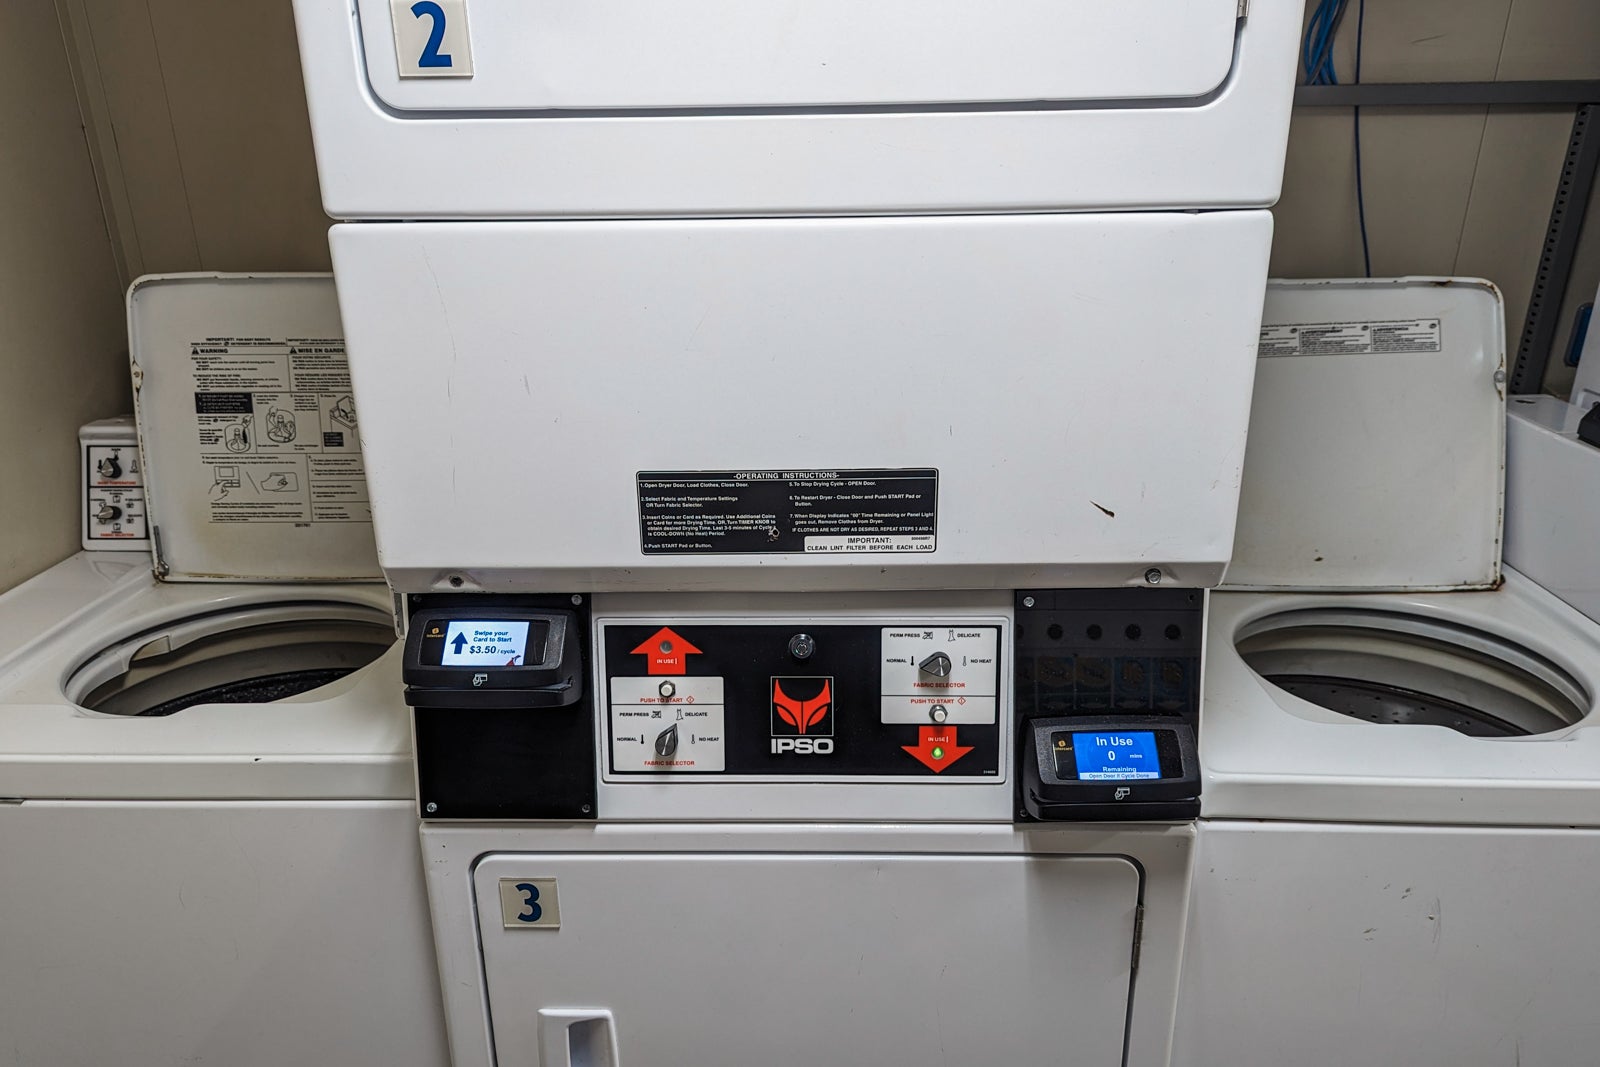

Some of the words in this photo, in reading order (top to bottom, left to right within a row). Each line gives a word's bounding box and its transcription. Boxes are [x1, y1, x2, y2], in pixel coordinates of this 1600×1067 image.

[410, 1, 452, 67] 2
[470, 646, 496, 654] $3.50
[771, 739, 834, 754] IPSO
[1096, 737, 1107, 746] In
[1111, 737, 1133, 746] Use
[1108, 751, 1116, 760] 0
[516, 883, 542, 922] 3
